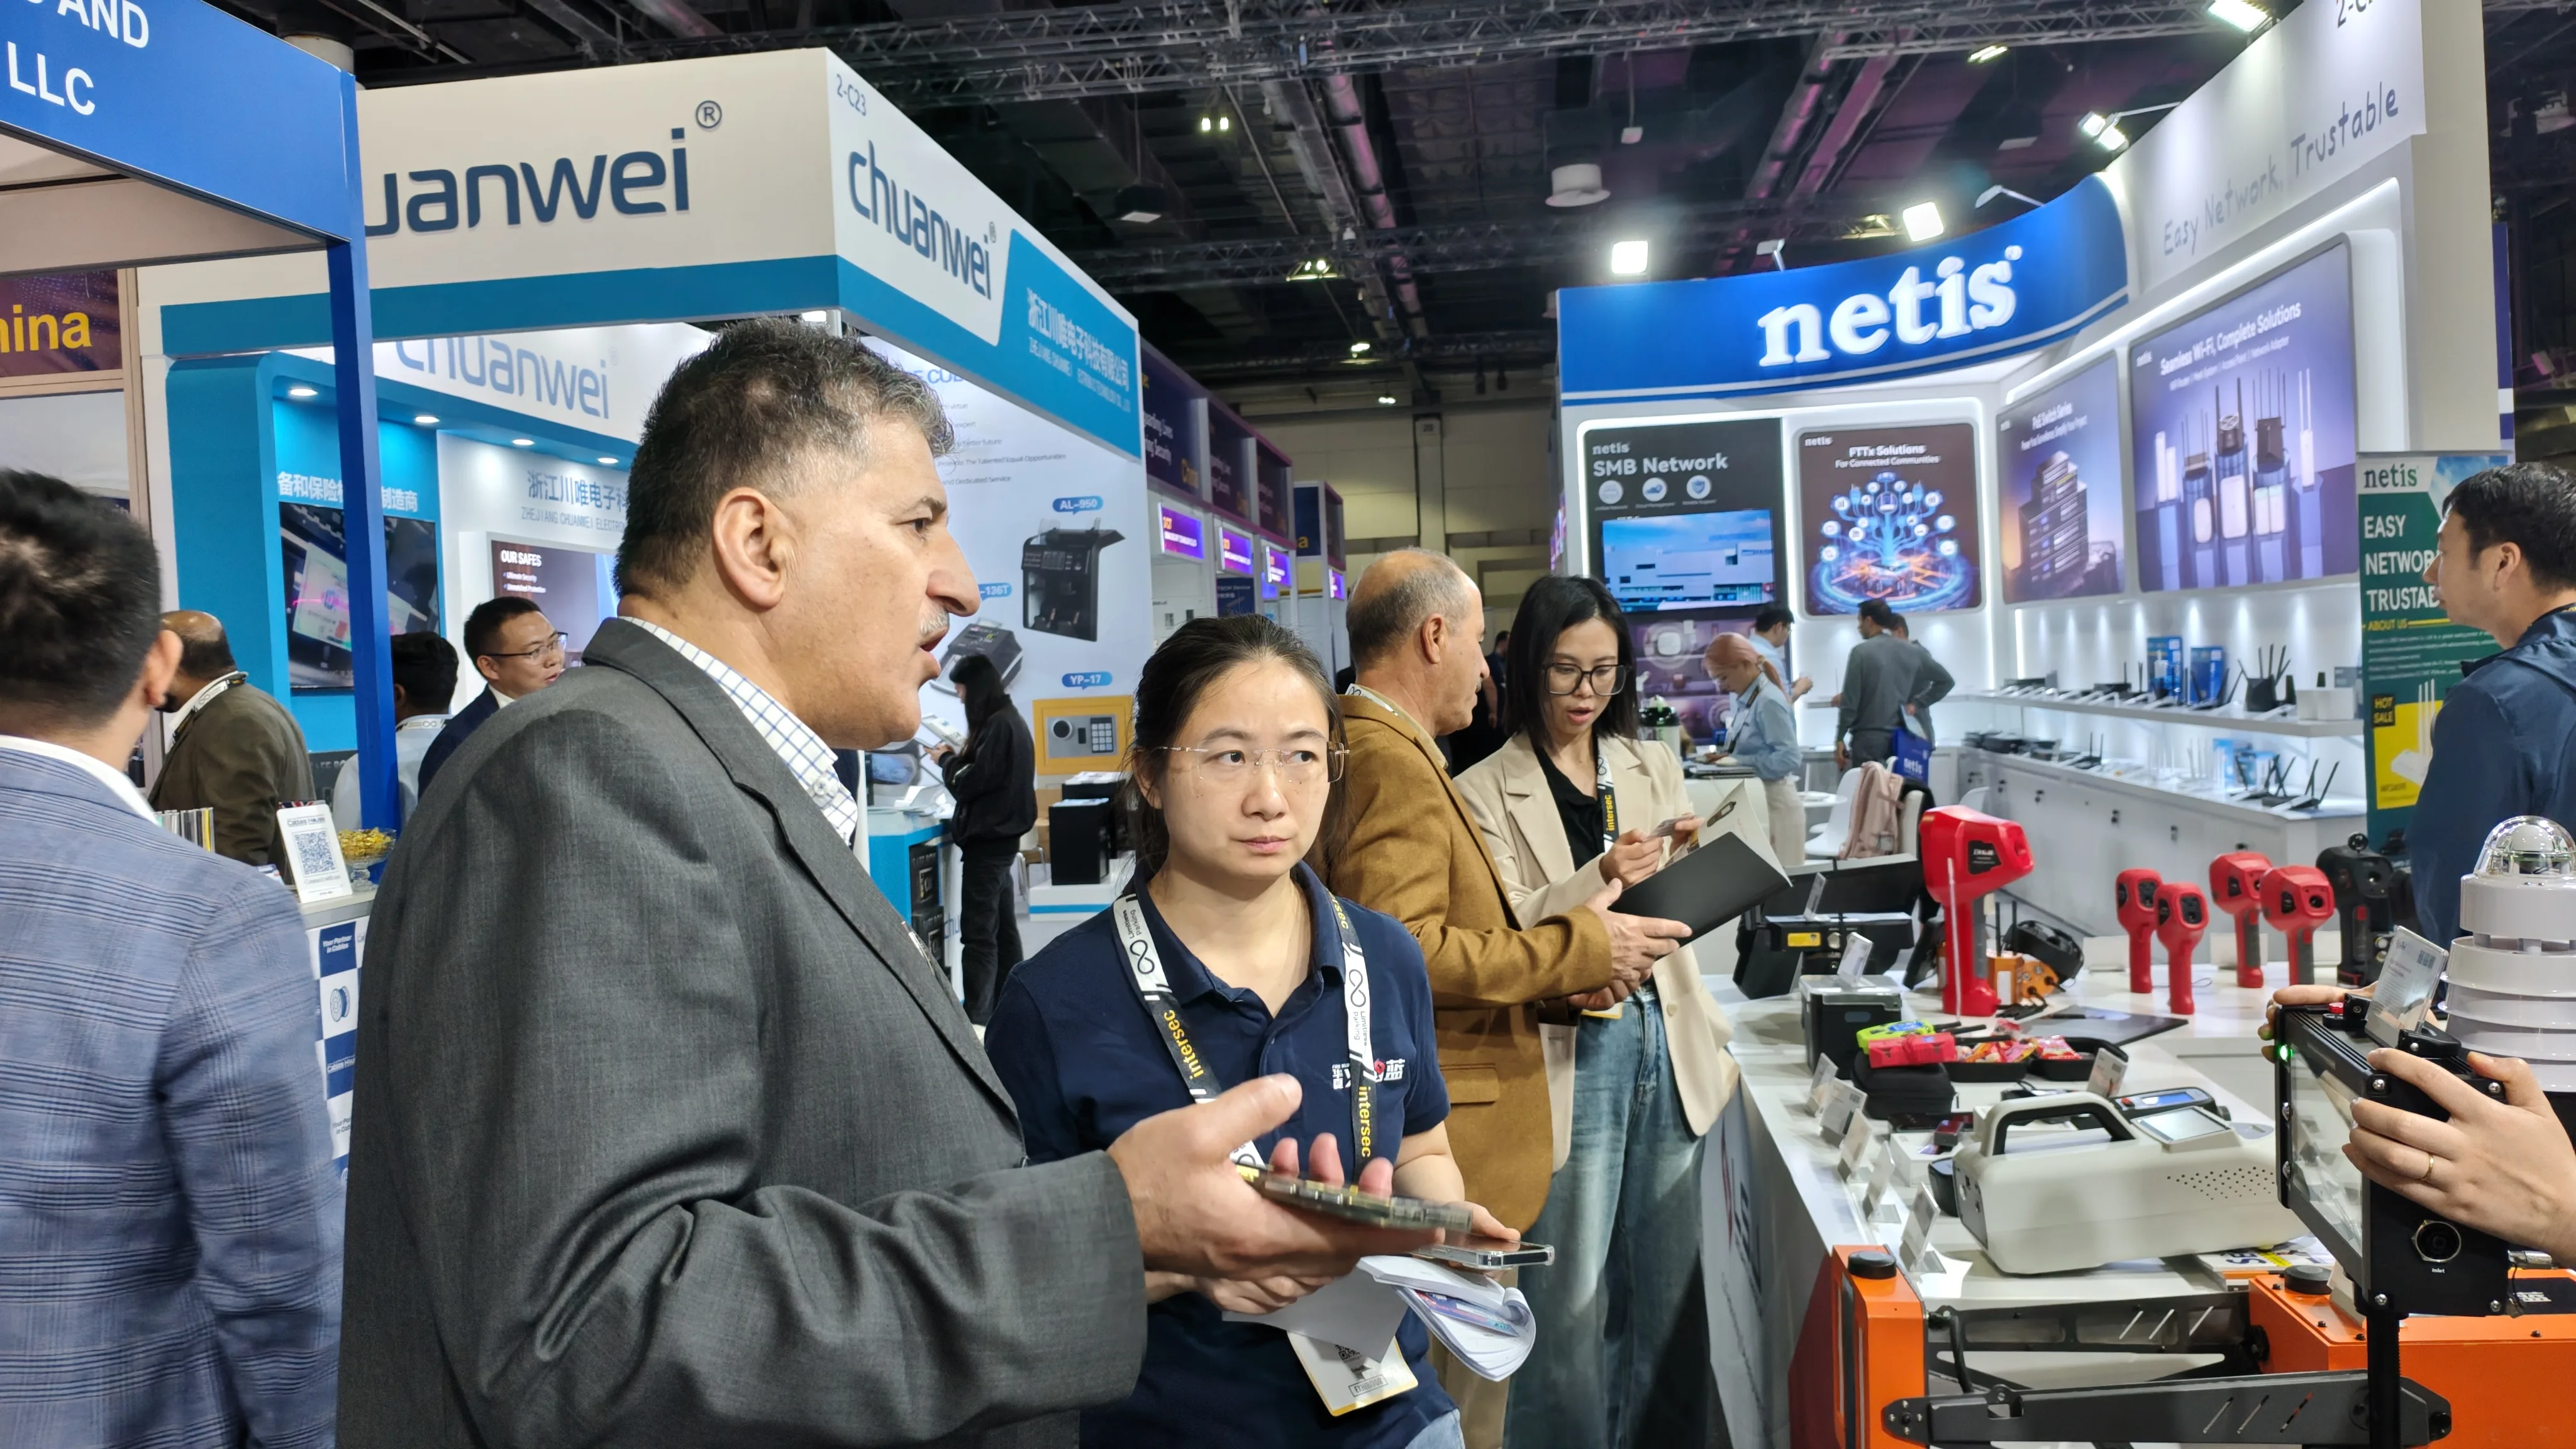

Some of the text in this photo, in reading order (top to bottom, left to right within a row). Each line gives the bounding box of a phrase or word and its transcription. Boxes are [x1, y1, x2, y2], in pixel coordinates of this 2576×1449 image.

[8, 41, 95, 115] LLC
[836, 74, 867, 118] 2-C23
[2164, 216, 2198, 256] Easy
[2290, 81, 2399, 177] Trustable
[848, 139, 992, 301] chuanwei
[1758, 256, 2016, 366] netis
[2216, 321, 2255, 351] Complete
[2257, 302, 2301, 333] Solutions
[1592, 441, 1629, 455] netis
[1875, 444, 1926, 457] Solutions
[1593, 452, 1728, 477] SMB Network
[2363, 463, 2418, 489] netis
[1060, 499, 1097, 510] AL-950
[2363, 514, 2406, 538] EASY
[501, 549, 542, 567] OUR SAFES
[2365, 549, 2443, 575] NETWOR
[980, 585, 1009, 596] -136T
[2367, 585, 2440, 612] TRUSTAB
[1070, 674, 1101, 685] YP-17
[2374, 696, 2394, 709] HOT
[2373, 711, 2394, 723] SALE
[1606, 794, 1615, 831] intersec
[1163, 1009, 1204, 1080] intersec
[1358, 1086, 1371, 1158] intersec
